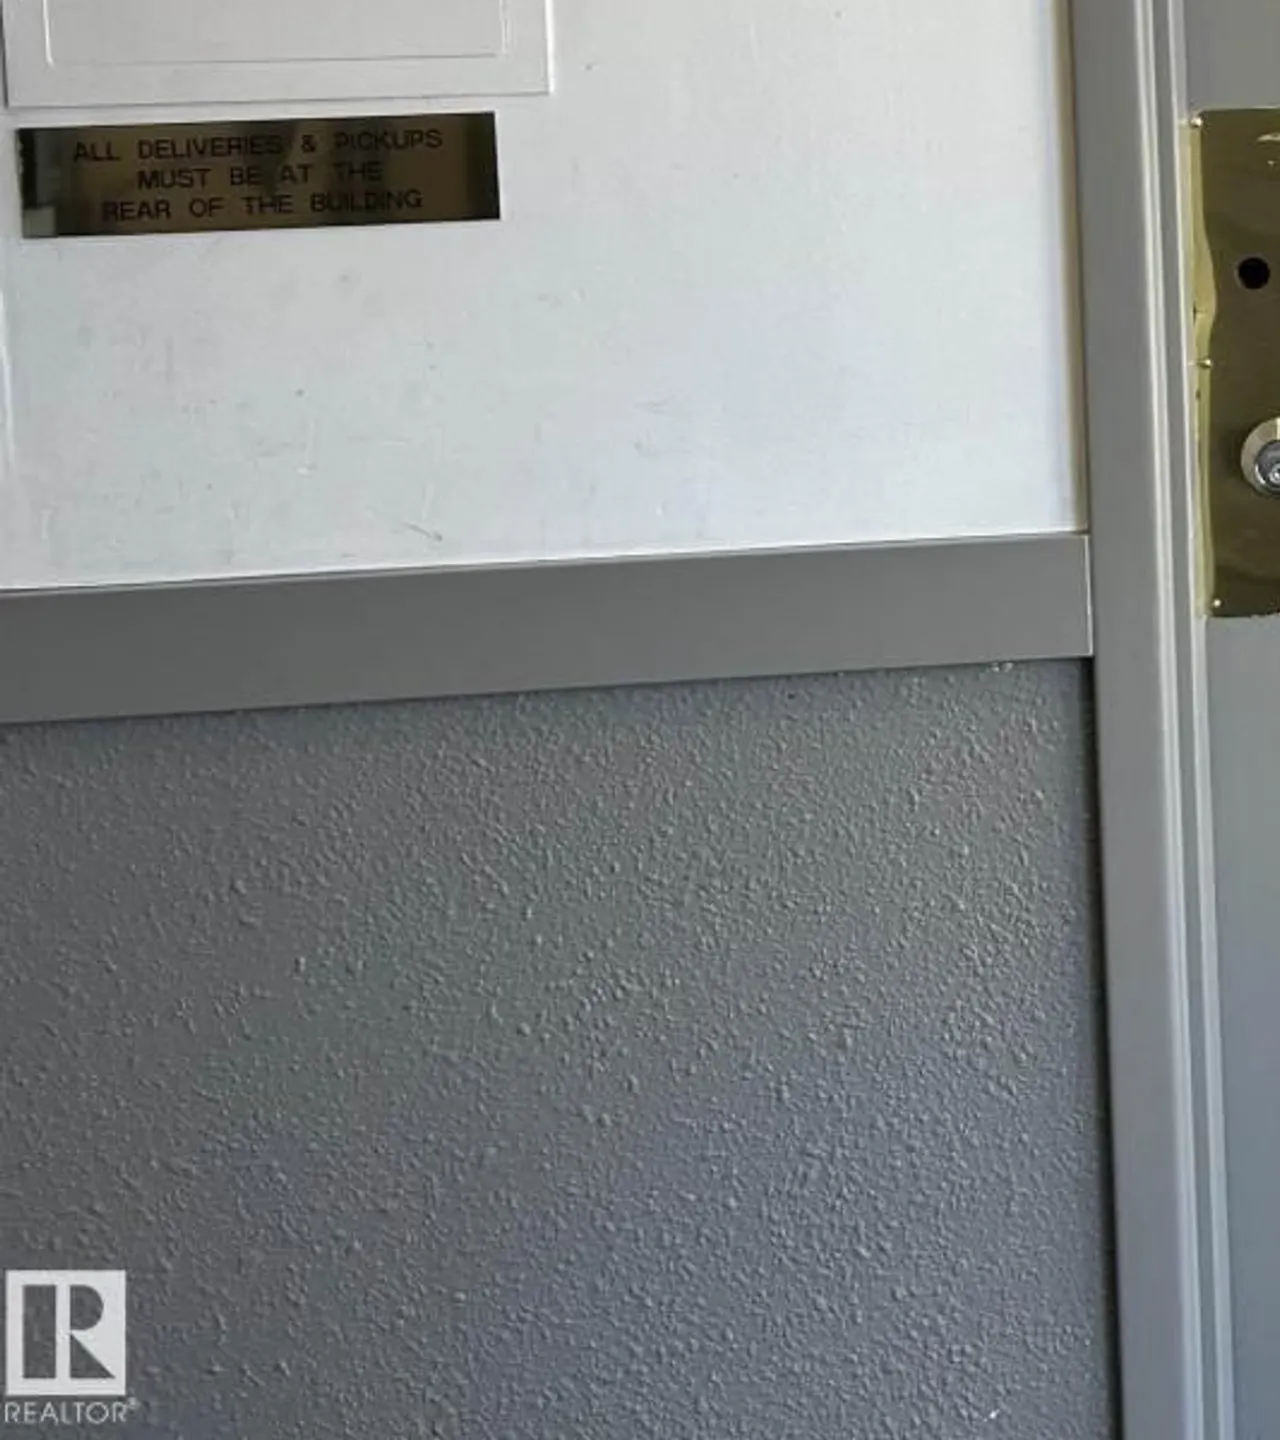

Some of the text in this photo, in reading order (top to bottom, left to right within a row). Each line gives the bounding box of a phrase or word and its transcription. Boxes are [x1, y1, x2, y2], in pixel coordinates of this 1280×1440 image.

[73, 128, 443, 161] ALL DELIVERIES & PICKUPS
[137, 160, 383, 189] MUST BE AT THE
[103, 189, 424, 222] REAR OF THE BUILDING
